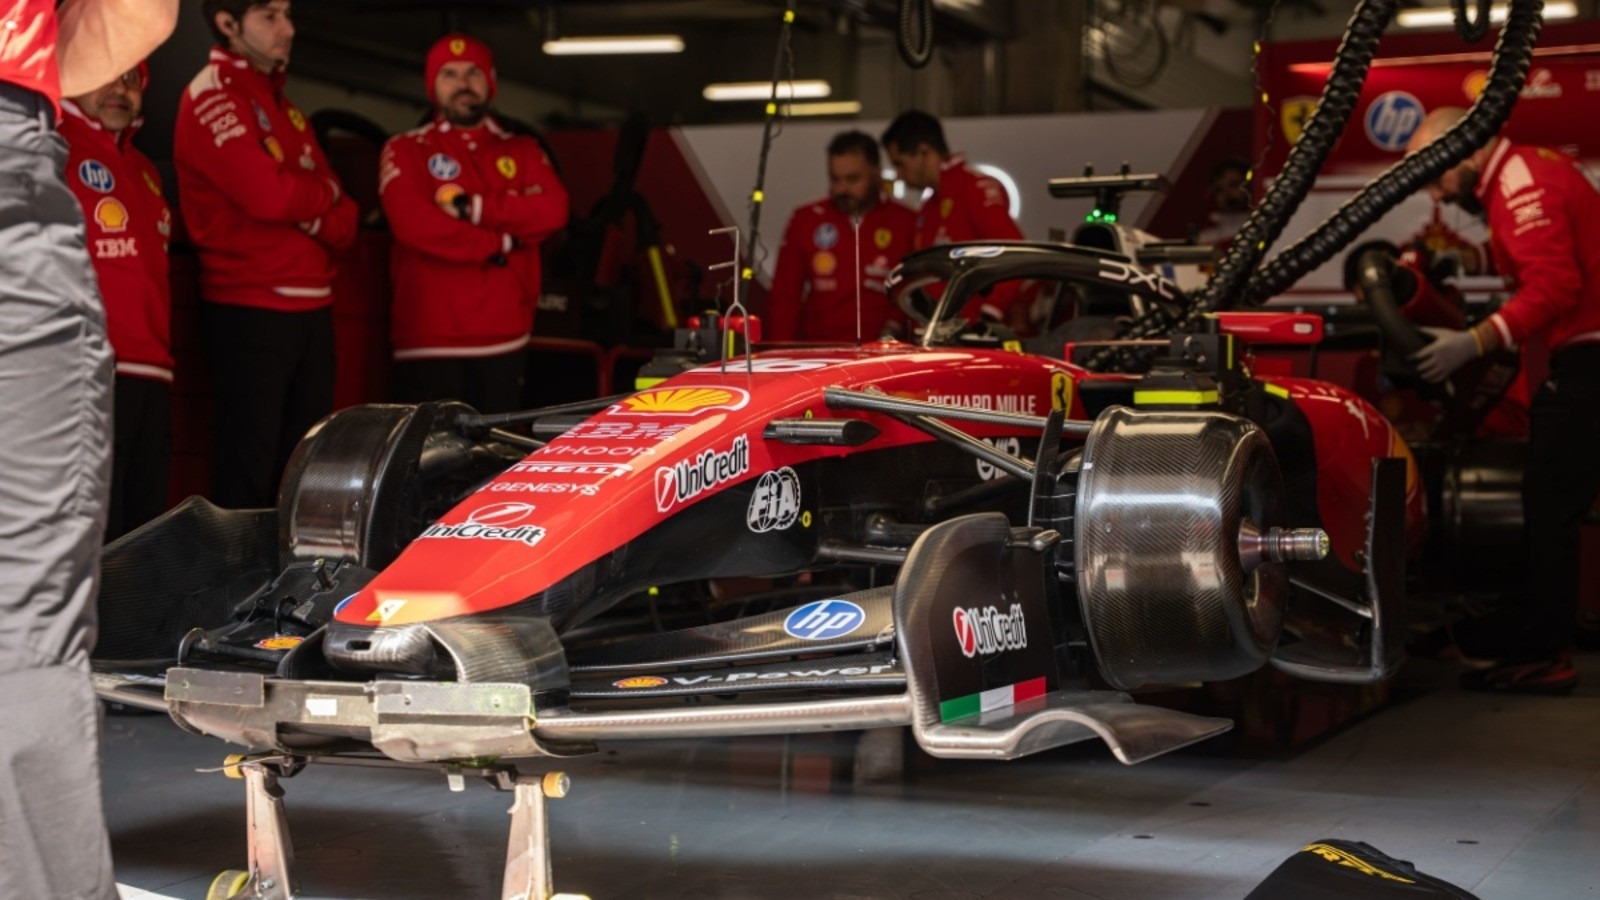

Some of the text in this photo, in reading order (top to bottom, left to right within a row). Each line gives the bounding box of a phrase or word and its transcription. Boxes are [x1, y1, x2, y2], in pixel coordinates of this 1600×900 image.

[1374, 94, 1417, 148] hp
[84, 160, 109, 191] hp
[95, 237, 138, 258] IBM
[1099, 257, 1175, 300] DXC
[996, 395, 1037, 415] MILLE
[554, 421, 692, 443] IBM
[675, 435, 749, 501] UniCredit
[490, 481, 600, 496] GENESYS
[792, 600, 858, 639] hp
[968, 604, 1027, 654] UniCredit
[672, 664, 895, 686] V-Power
